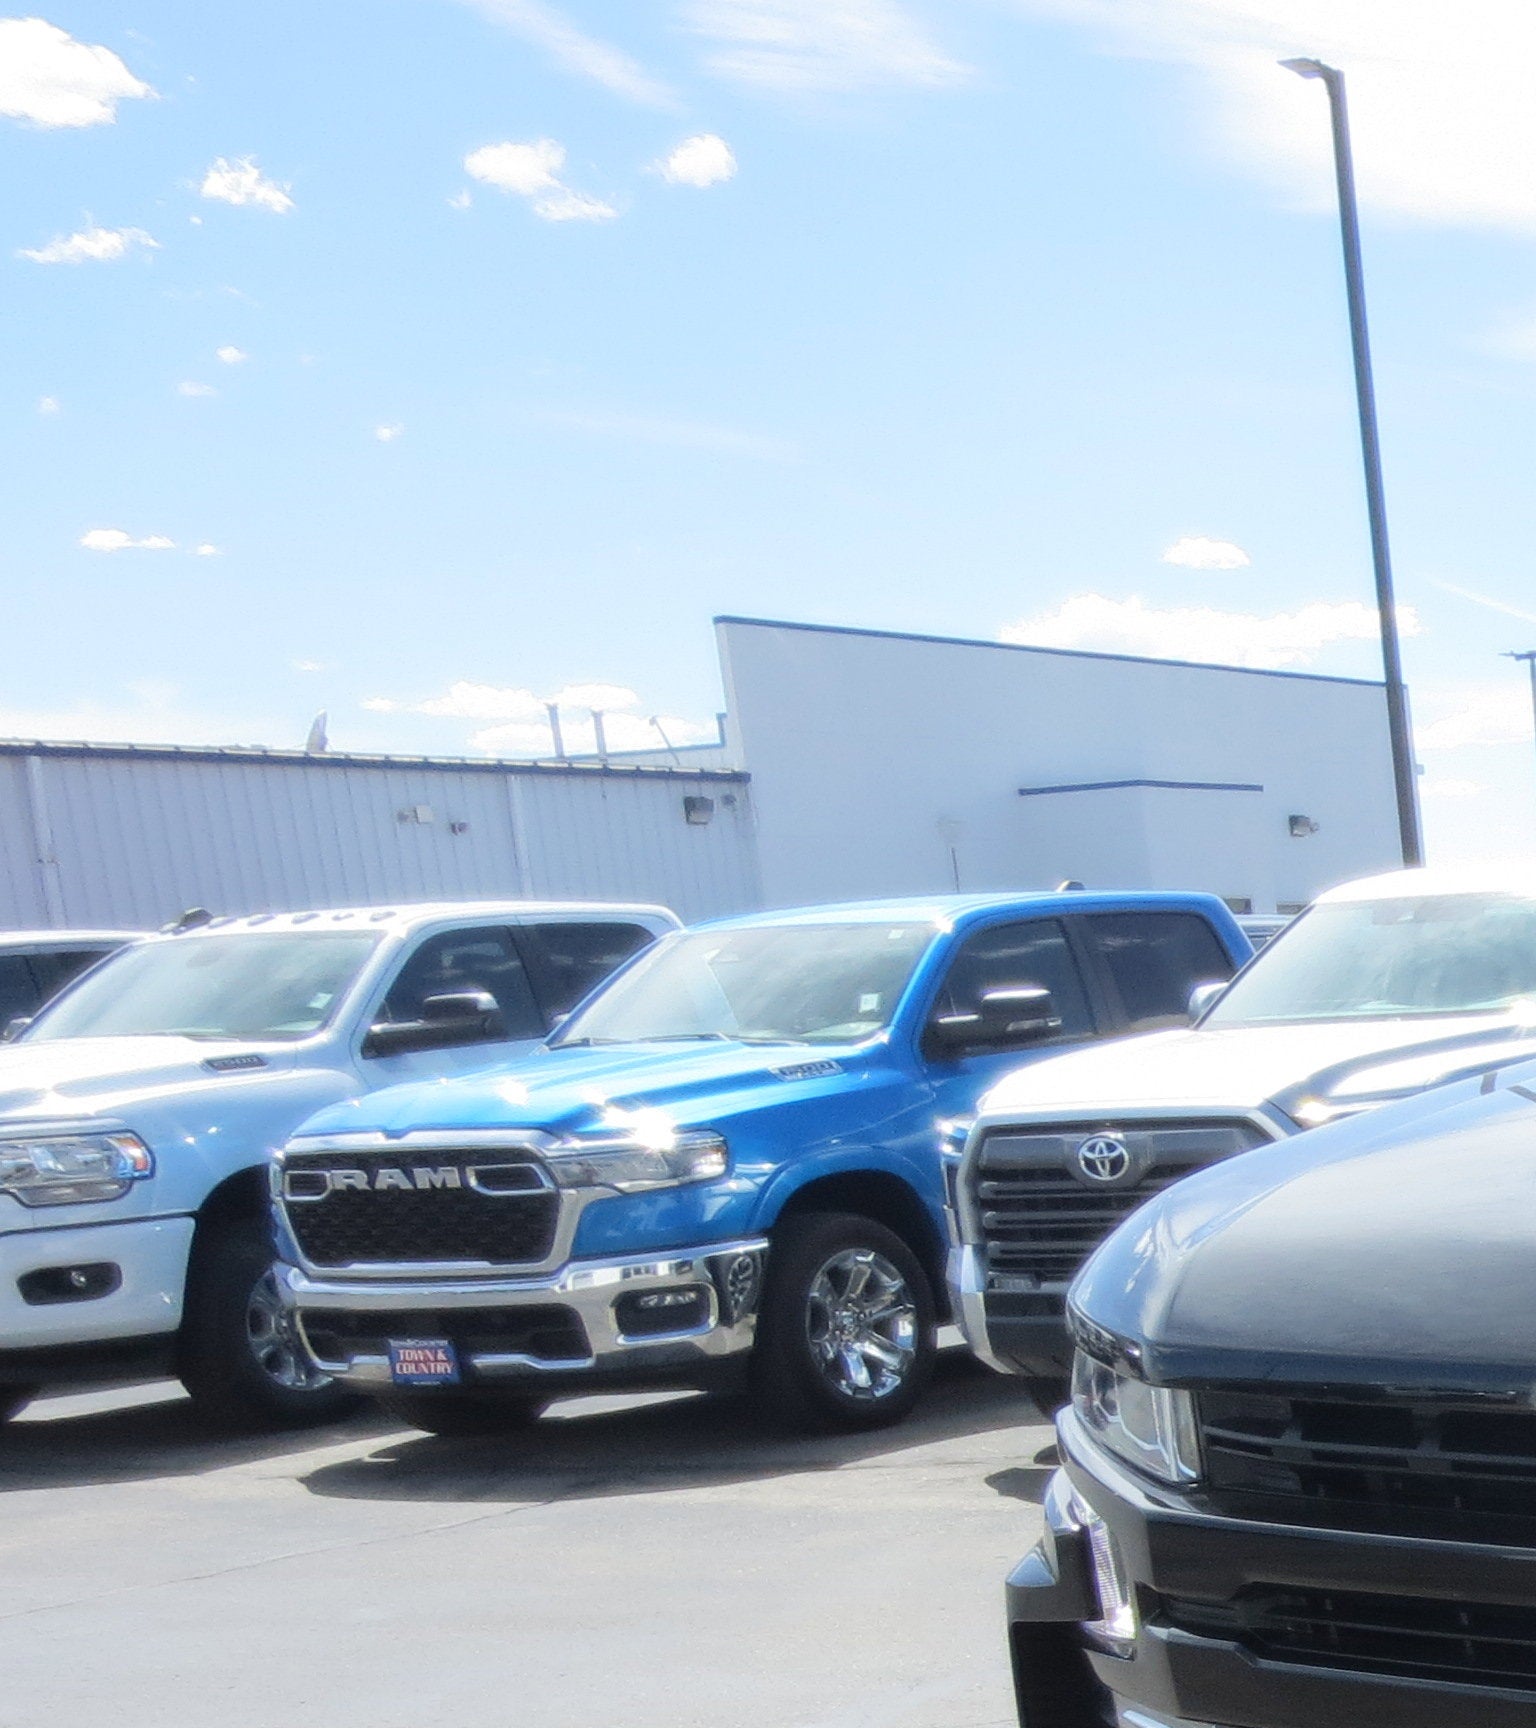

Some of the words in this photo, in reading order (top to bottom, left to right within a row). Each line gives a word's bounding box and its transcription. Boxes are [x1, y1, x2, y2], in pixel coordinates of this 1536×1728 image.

[330, 1166, 461, 1190] RAM
[398, 1349, 436, 1361] TOWN
[396, 1361, 454, 1374] COUNTRY
